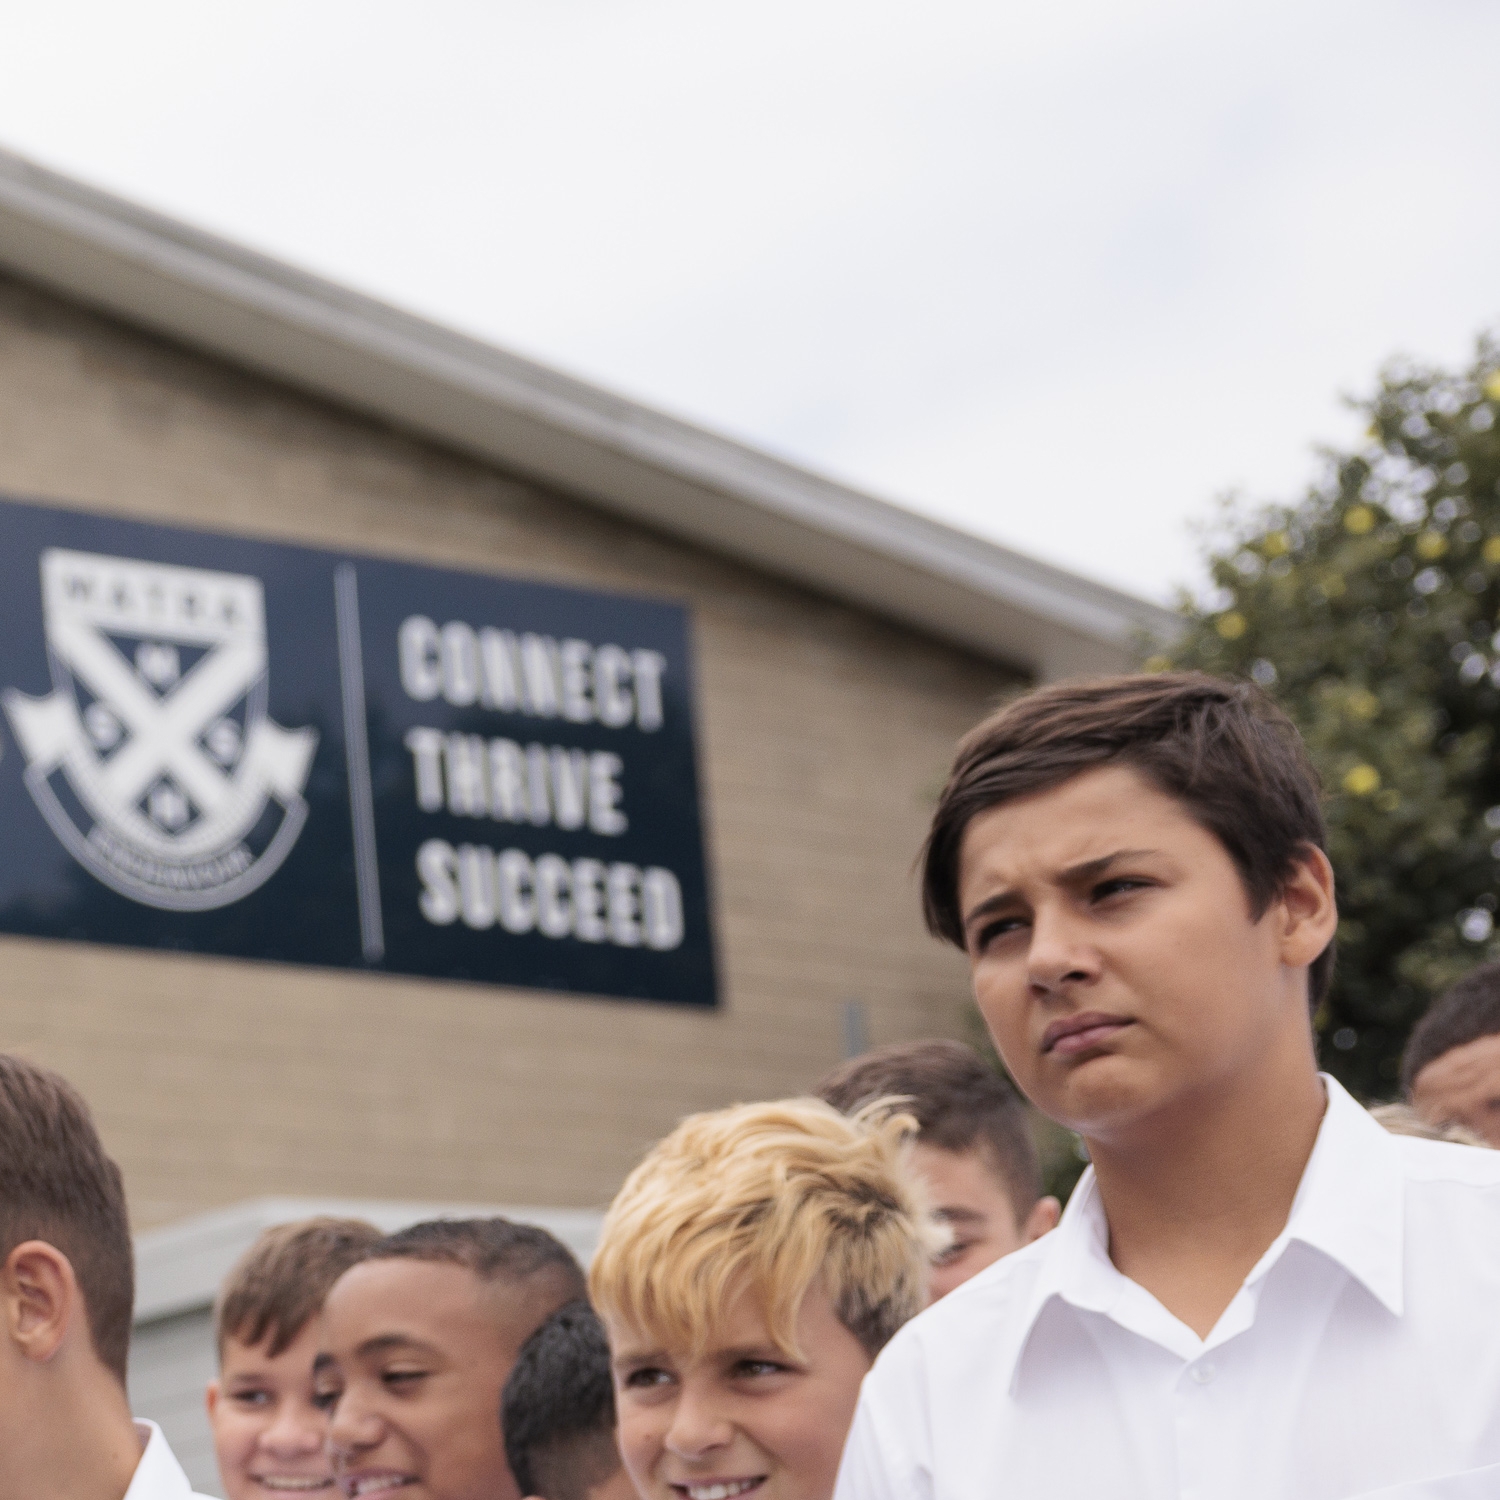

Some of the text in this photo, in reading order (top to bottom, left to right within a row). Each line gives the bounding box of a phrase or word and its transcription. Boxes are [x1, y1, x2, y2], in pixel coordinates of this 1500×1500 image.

[398, 614, 667, 732] CONNECT
[404, 726, 629, 836] THRIVE
[416, 837, 685, 951] SUCCEED
